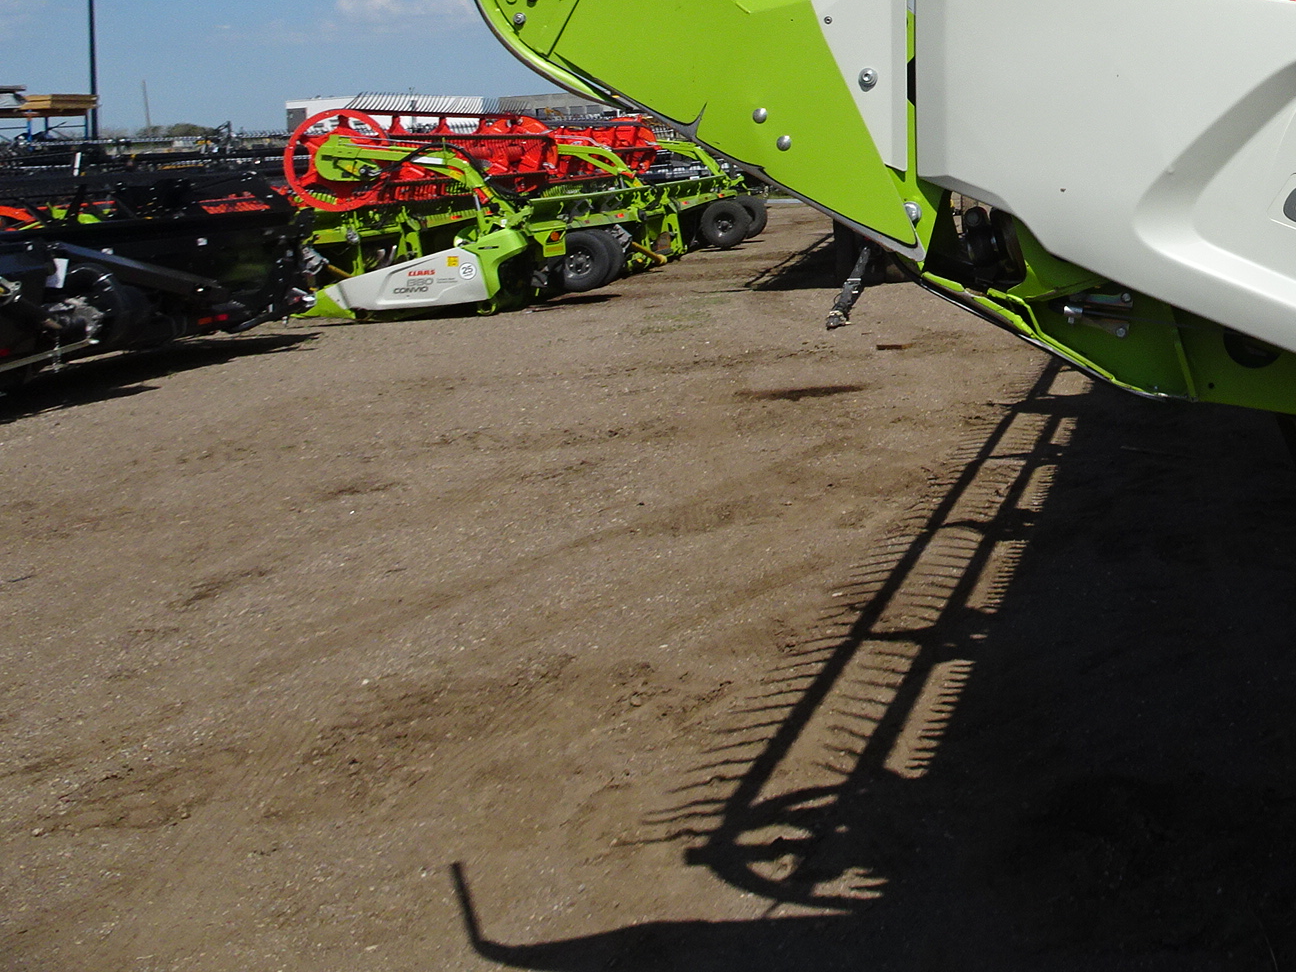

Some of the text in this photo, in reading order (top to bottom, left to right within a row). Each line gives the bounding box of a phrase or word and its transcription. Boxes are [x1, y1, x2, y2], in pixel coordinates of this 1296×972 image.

[408, 269, 436, 277] CLAAS
[461, 265, 474, 275] 25
[393, 286, 429, 294] CONVIO
